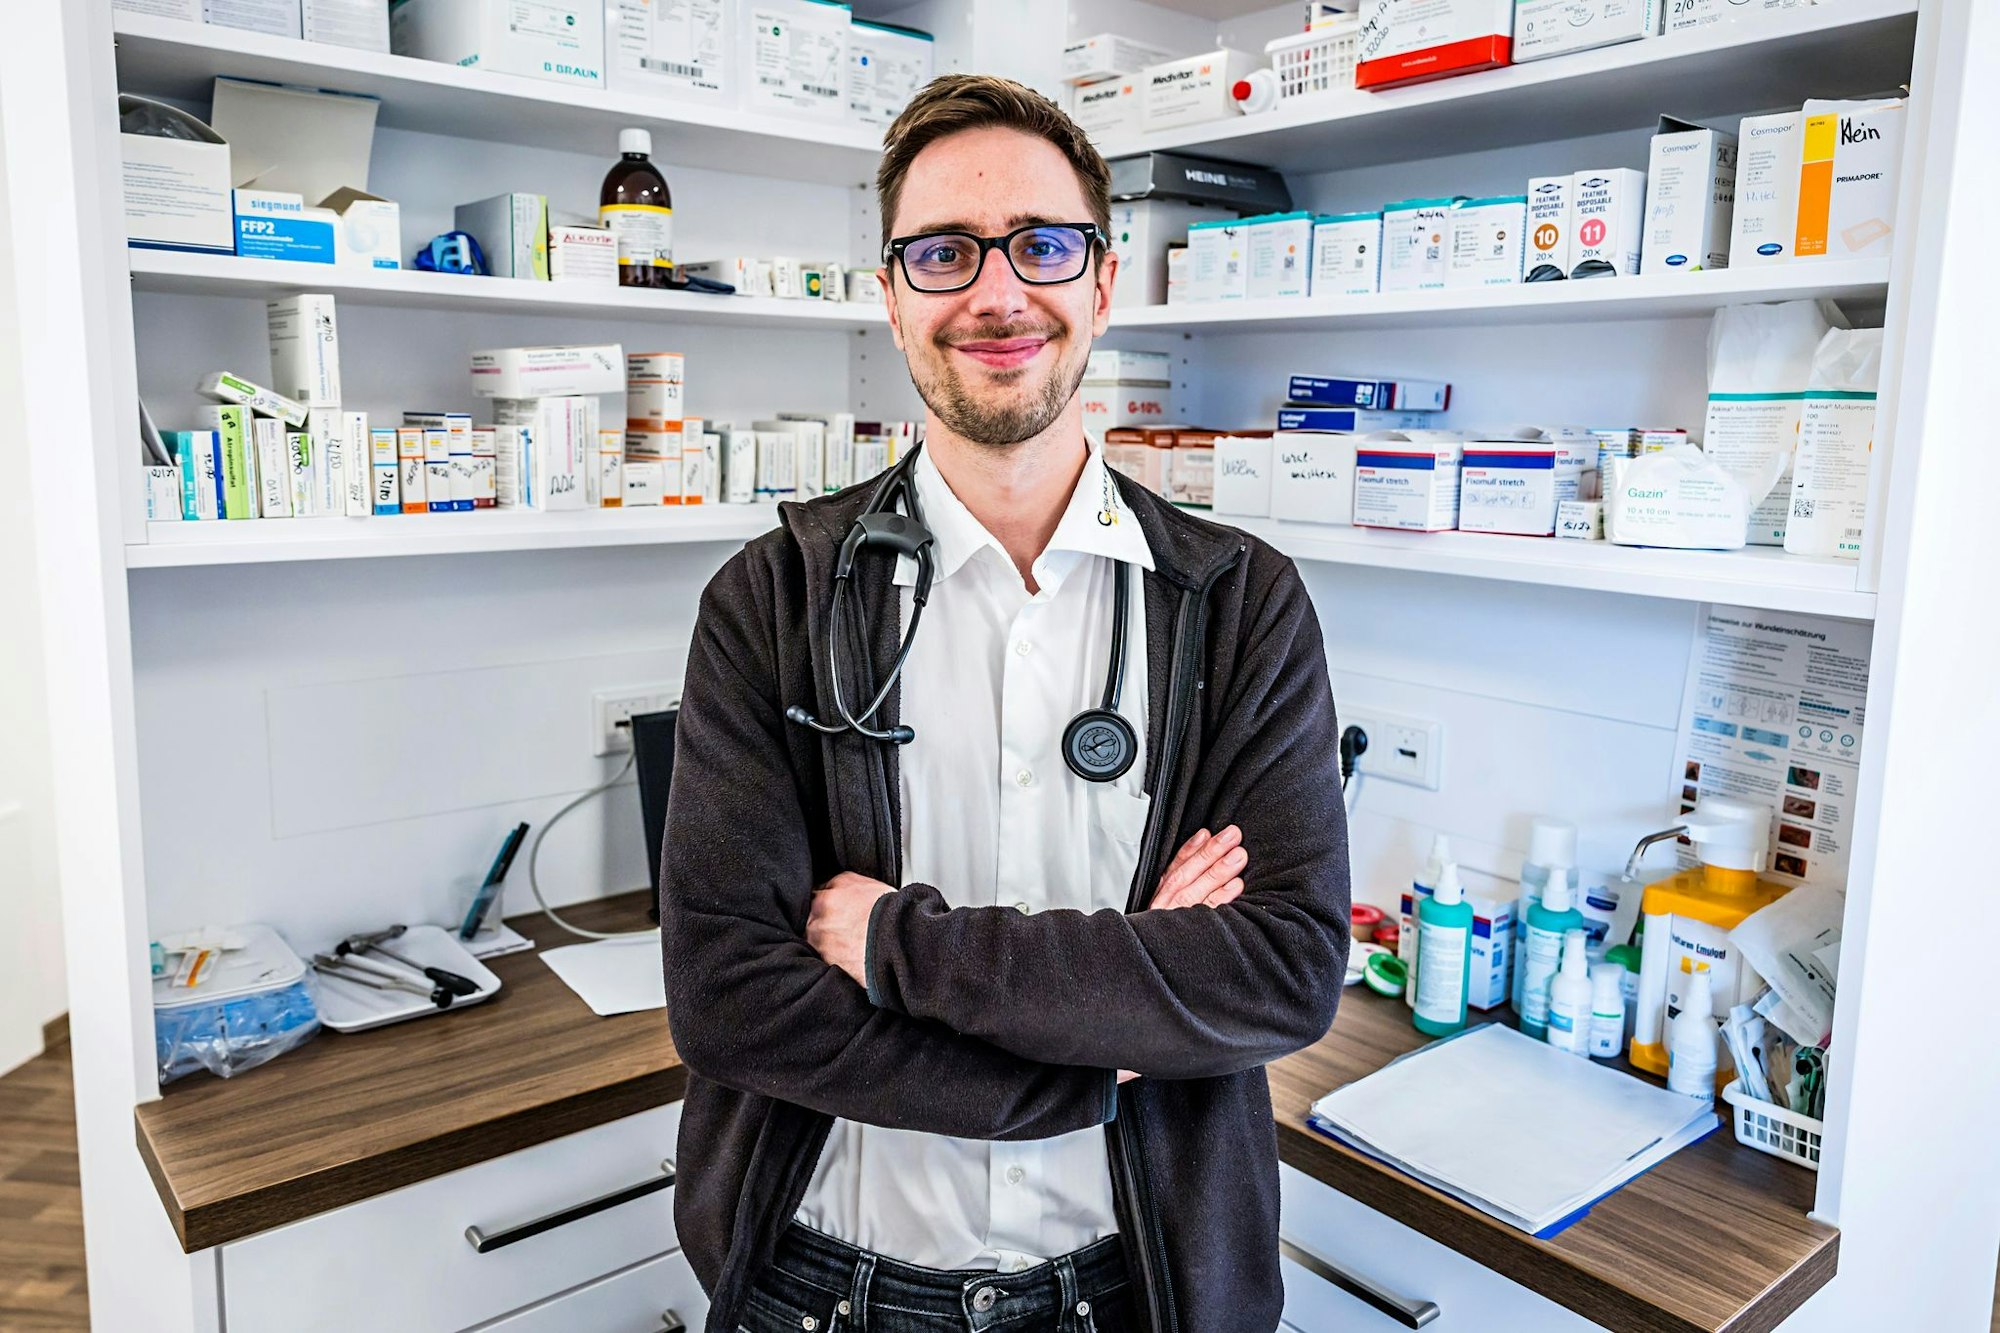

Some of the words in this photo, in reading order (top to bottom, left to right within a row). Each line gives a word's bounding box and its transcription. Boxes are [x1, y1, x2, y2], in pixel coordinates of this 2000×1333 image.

[556, 64, 598, 79] BRAUN
[1751, 124, 1793, 138] Cosmopor
[1840, 118, 1881, 146] Klein
[1662, 143, 1698, 154] Cosmopor
[1185, 169, 1228, 187] HEINE
[1836, 173, 1880, 184] PRIMAPORE
[1535, 195, 1561, 204] FEATHER
[1581, 190, 1608, 198] FEATHER
[251, 199, 301, 212] siegmund
[1531, 202, 1565, 212] DISPOSABLE
[1577, 197, 1612, 208] DISPOSABLE
[1535, 211, 1560, 219] SCALPEL
[1581, 206, 1607, 214] SCALPEL
[240, 220, 276, 235] FFP2
[1583, 225, 1601, 241] 11
[1536, 229, 1556, 246] 10
[1536, 253, 1546, 261] 20
[1582, 250, 1594, 258] 20
[226, 437, 236, 488] Atropinsulfat
[1358, 476, 1384, 485] Fixomull
[1385, 477, 1409, 486] stretch
[1465, 478, 1497, 487] Fixomull
[1498, 478, 1526, 487] stretch
[1627, 487, 1664, 500] Gazin
[1626, 507, 1637, 515] 10
[1754, 622, 1827, 641] Wundeinschätzung
